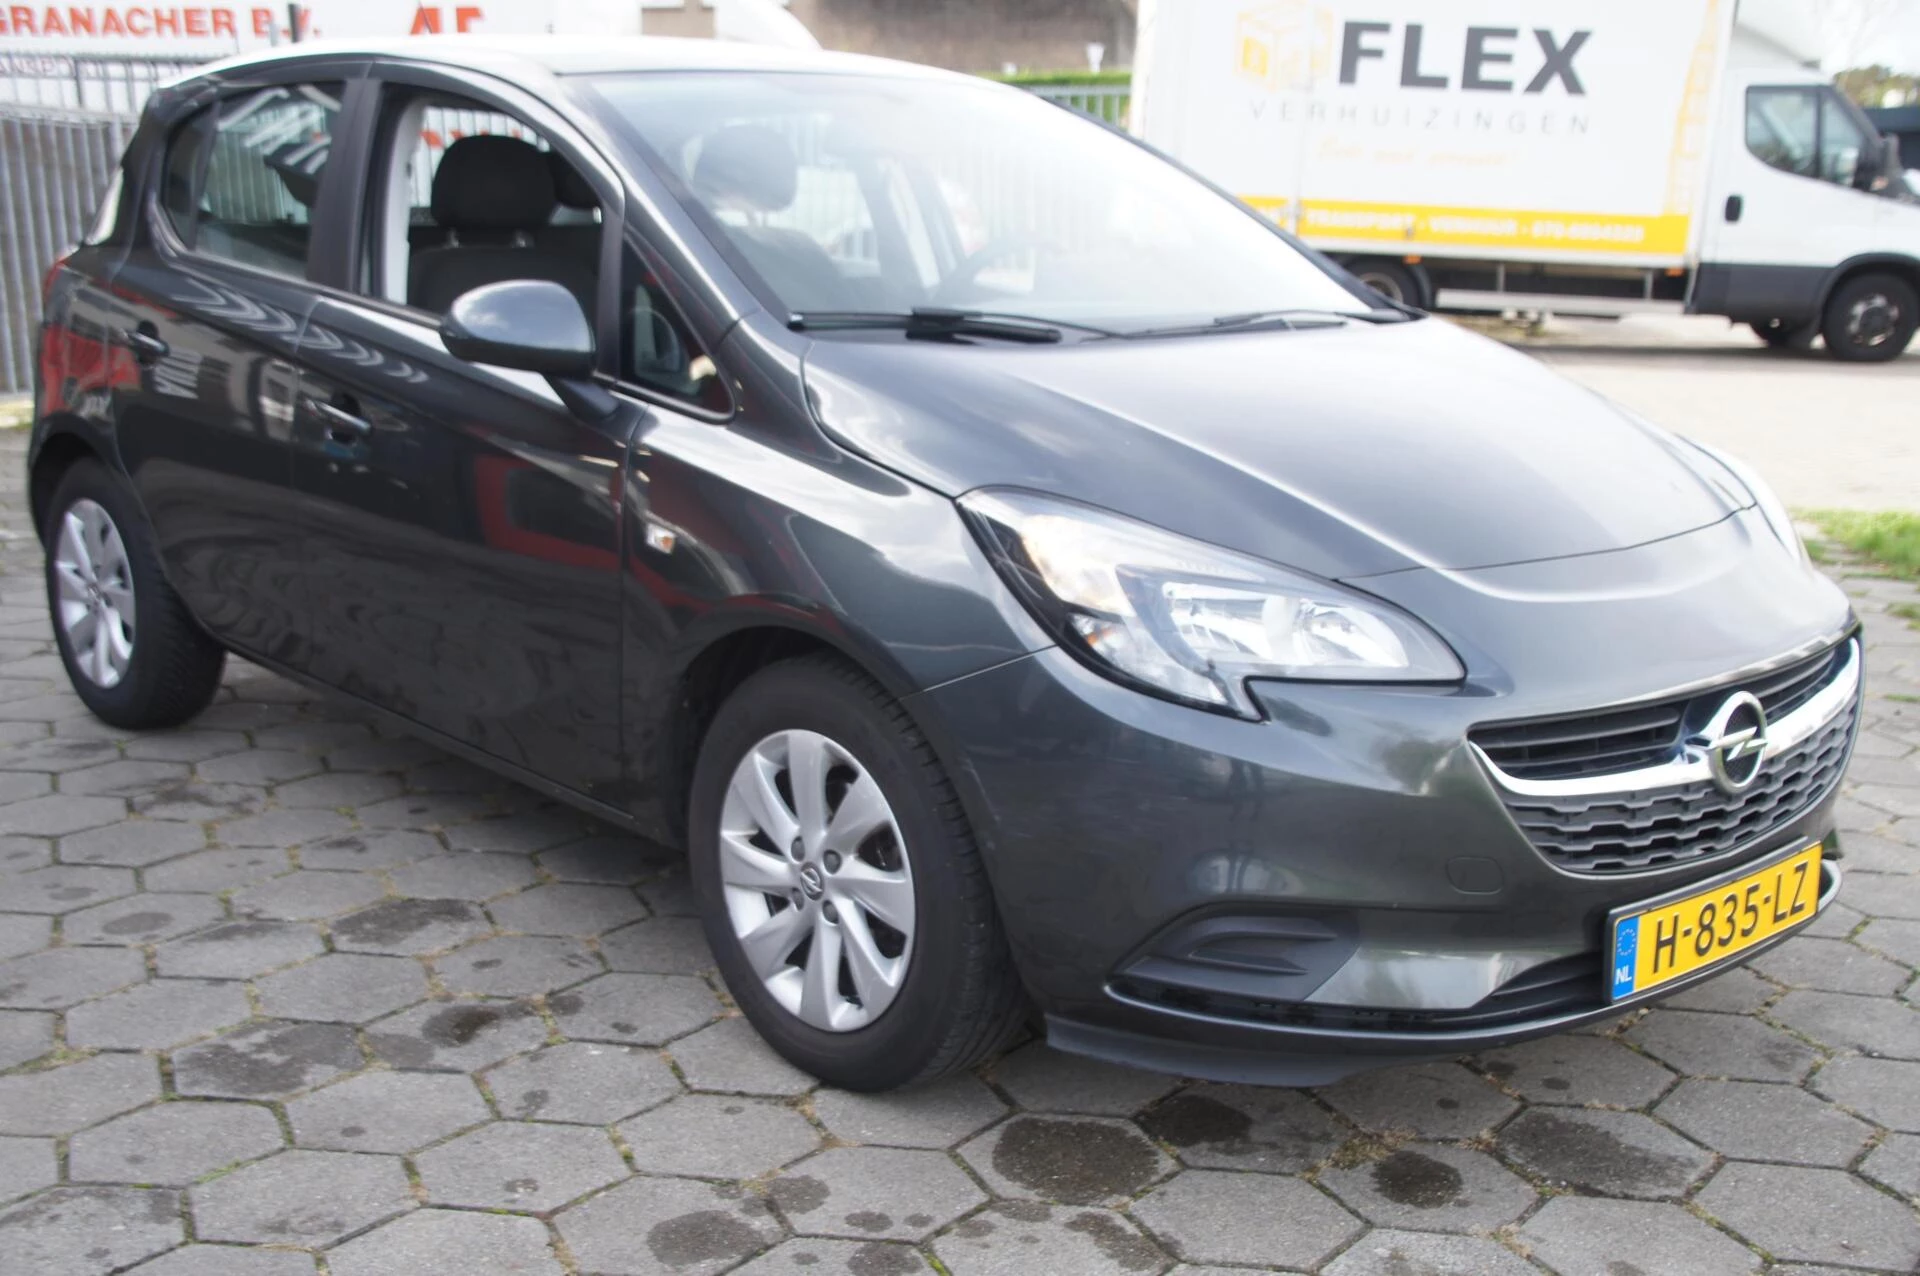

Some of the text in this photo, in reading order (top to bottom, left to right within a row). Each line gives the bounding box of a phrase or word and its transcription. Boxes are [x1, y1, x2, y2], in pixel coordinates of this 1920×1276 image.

[1338, 20, 1593, 96] FLEX
[1249, 99, 1590, 134] VERHUIZINGEN
[1652, 861, 1809, 974] H-835-LZ
[1615, 965, 1632, 985] NL
